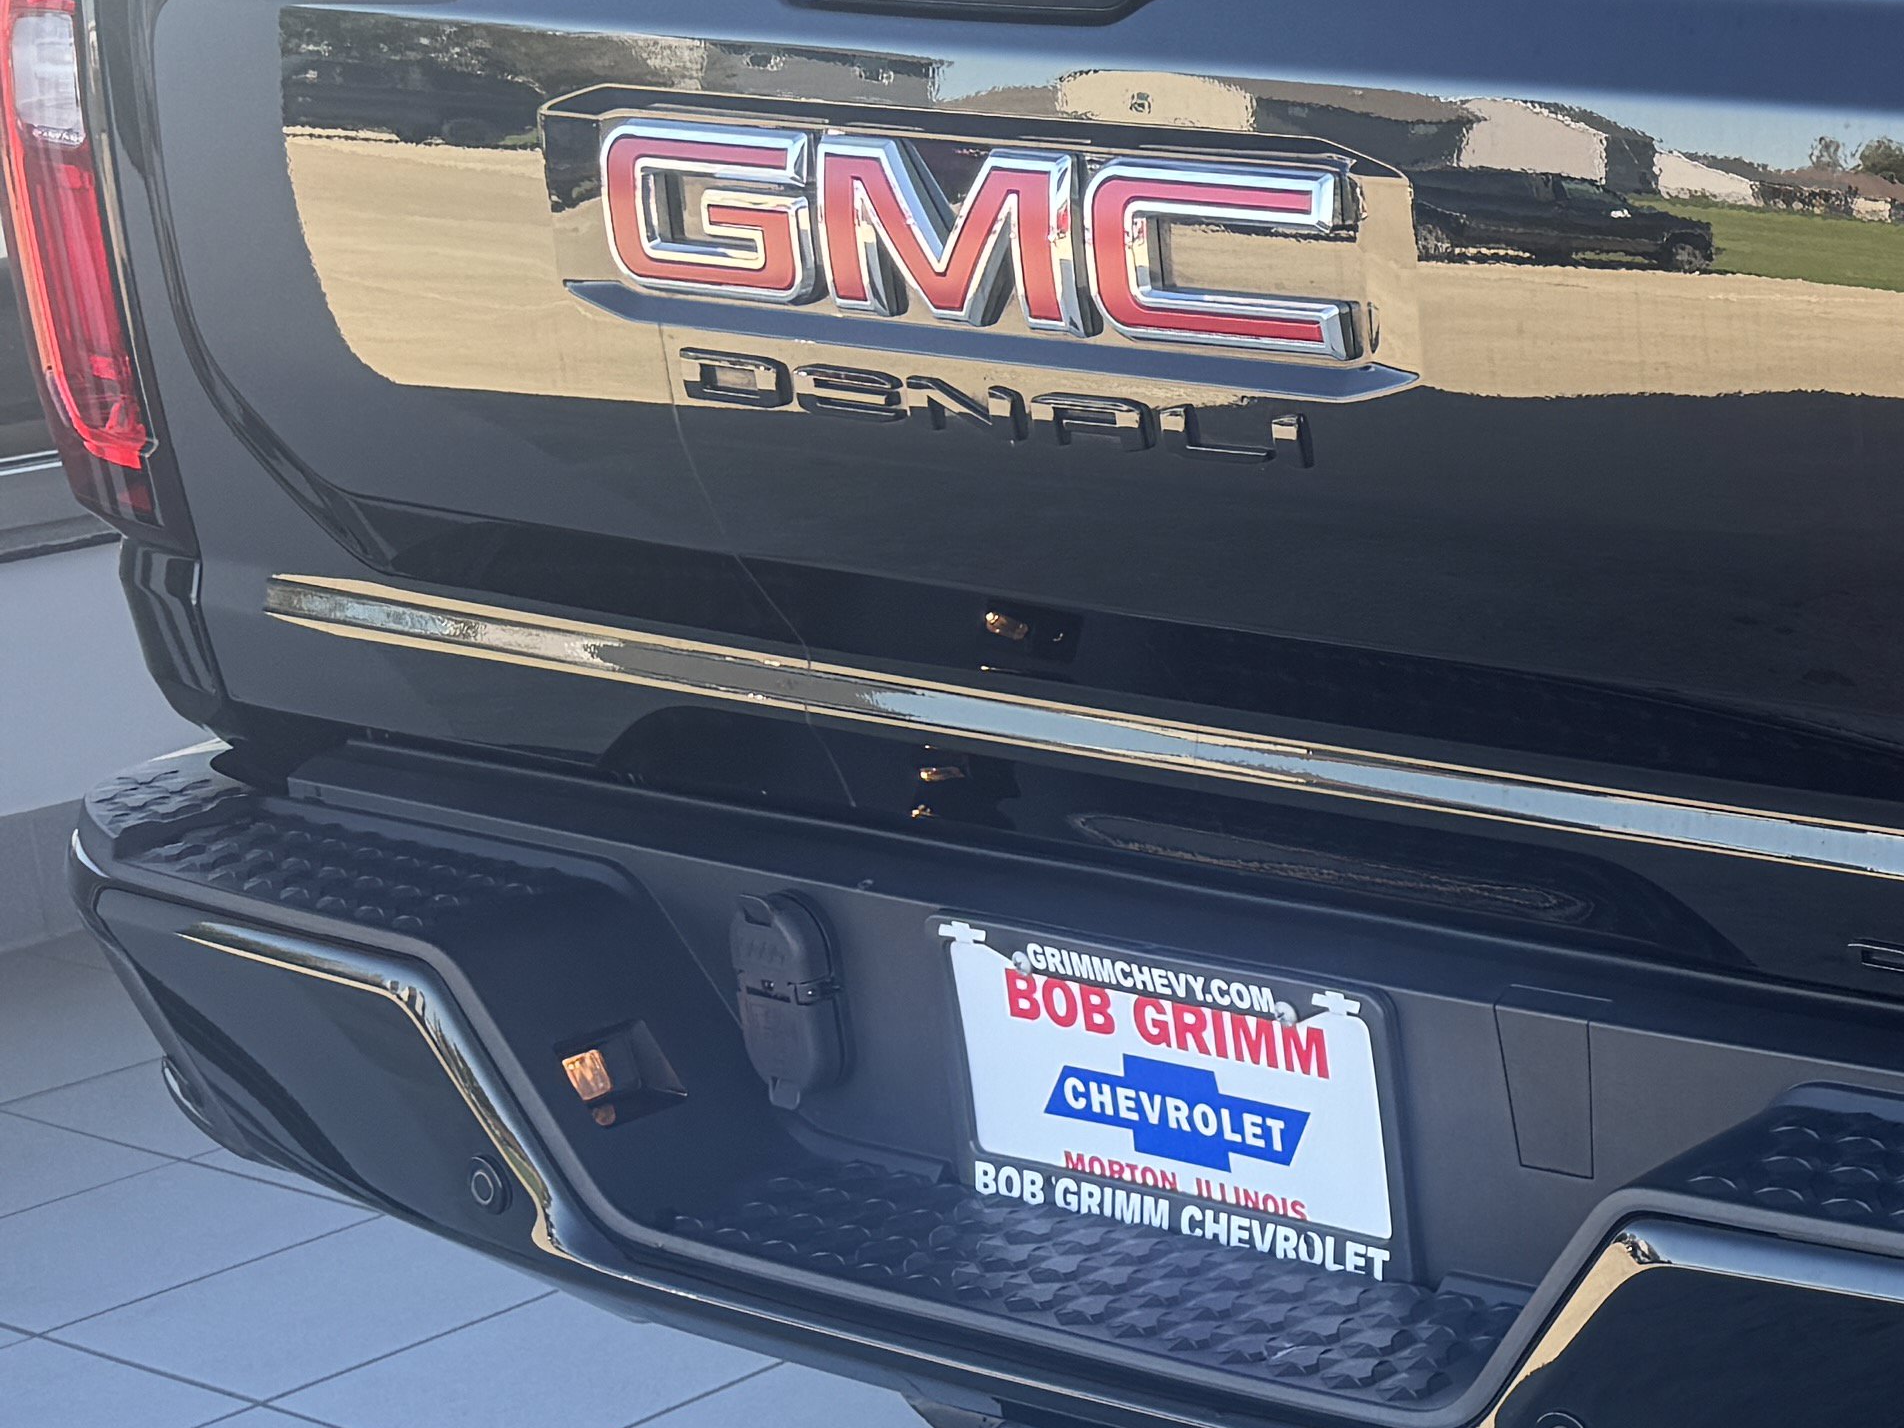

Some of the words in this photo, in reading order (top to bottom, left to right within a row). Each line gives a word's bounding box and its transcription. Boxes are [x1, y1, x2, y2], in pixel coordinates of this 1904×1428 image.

[600, 116, 1363, 362] GMC
[678, 346, 1314, 469] DENALI
[1003, 967, 1117, 1035] BOB
[1133, 993, 1330, 1080] GRIMM
[1026, 942, 1276, 1014] GRIMMCHEVY.COM
[1063, 1076, 1286, 1154] CHEVROLET
[974, 1160, 1046, 1205] BOB
[1055, 1178, 1171, 1231] GRIMM
[1180, 1204, 1392, 1282] CHEVROLET
